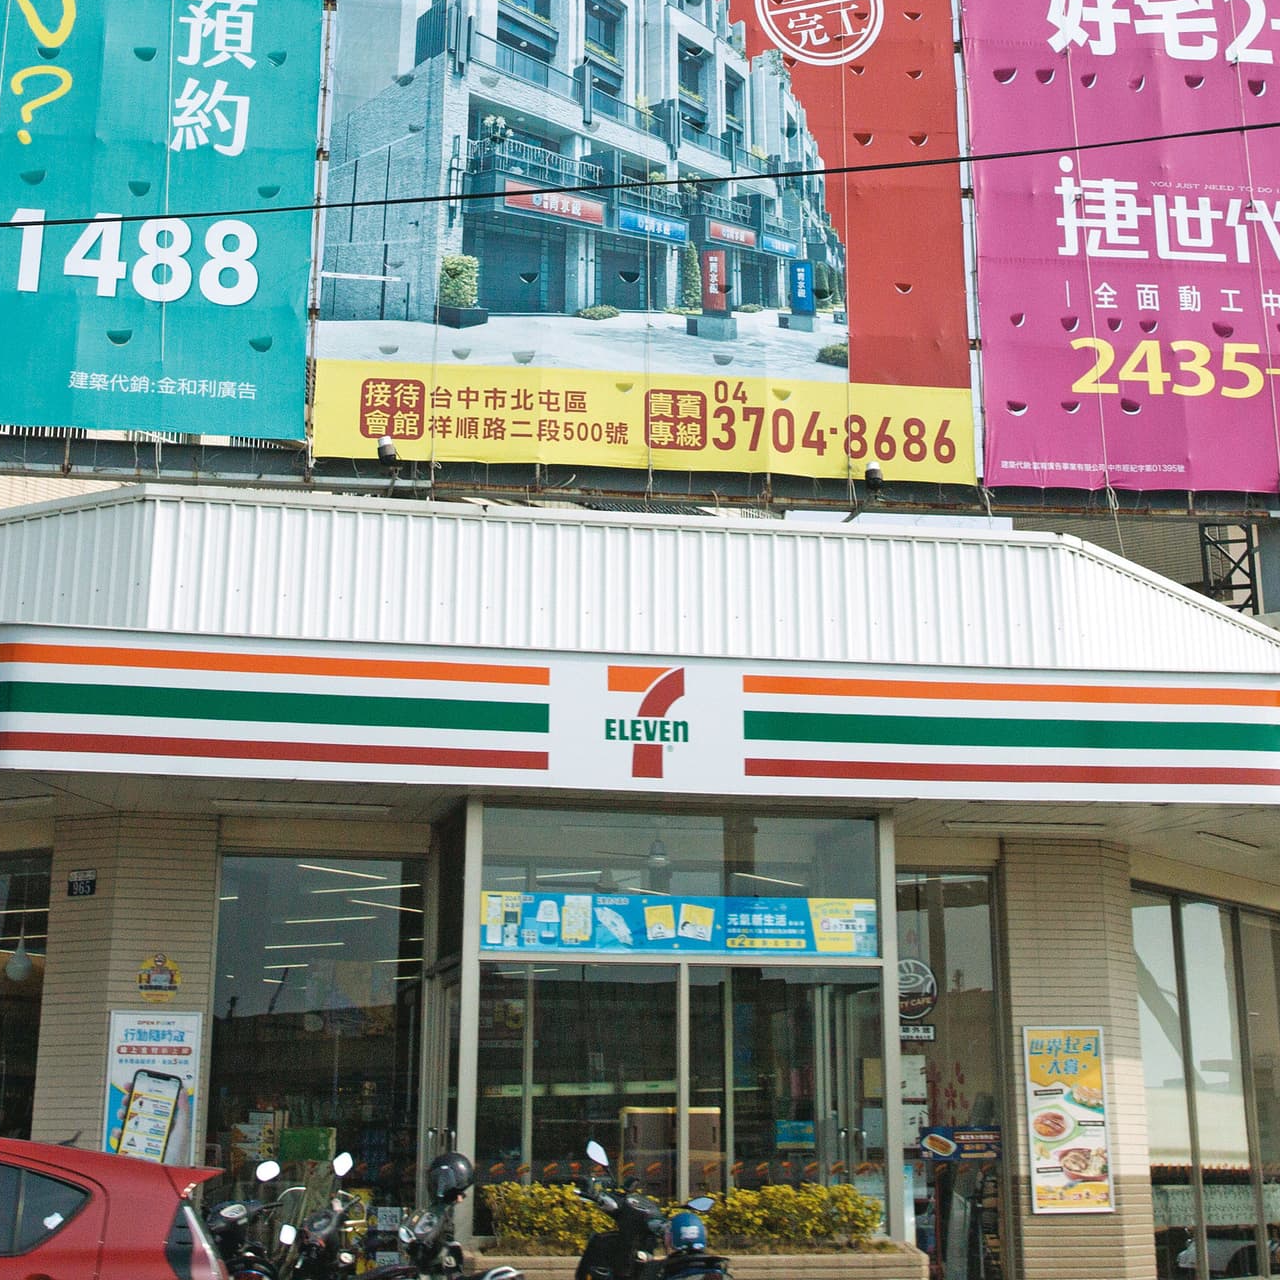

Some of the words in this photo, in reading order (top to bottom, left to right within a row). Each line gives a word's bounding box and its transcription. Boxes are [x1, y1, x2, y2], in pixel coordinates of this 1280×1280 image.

[788, 4, 867, 48] 完工
[365, 380, 421, 408] 接待
[430, 385, 588, 414] 台中市北屯區
[648, 391, 703, 419] 貴賓
[713, 380, 748, 405] 04
[365, 410, 419, 439] 會館
[427, 414, 630, 446] 祥順路二段500號
[647, 420, 703, 448] 專線
